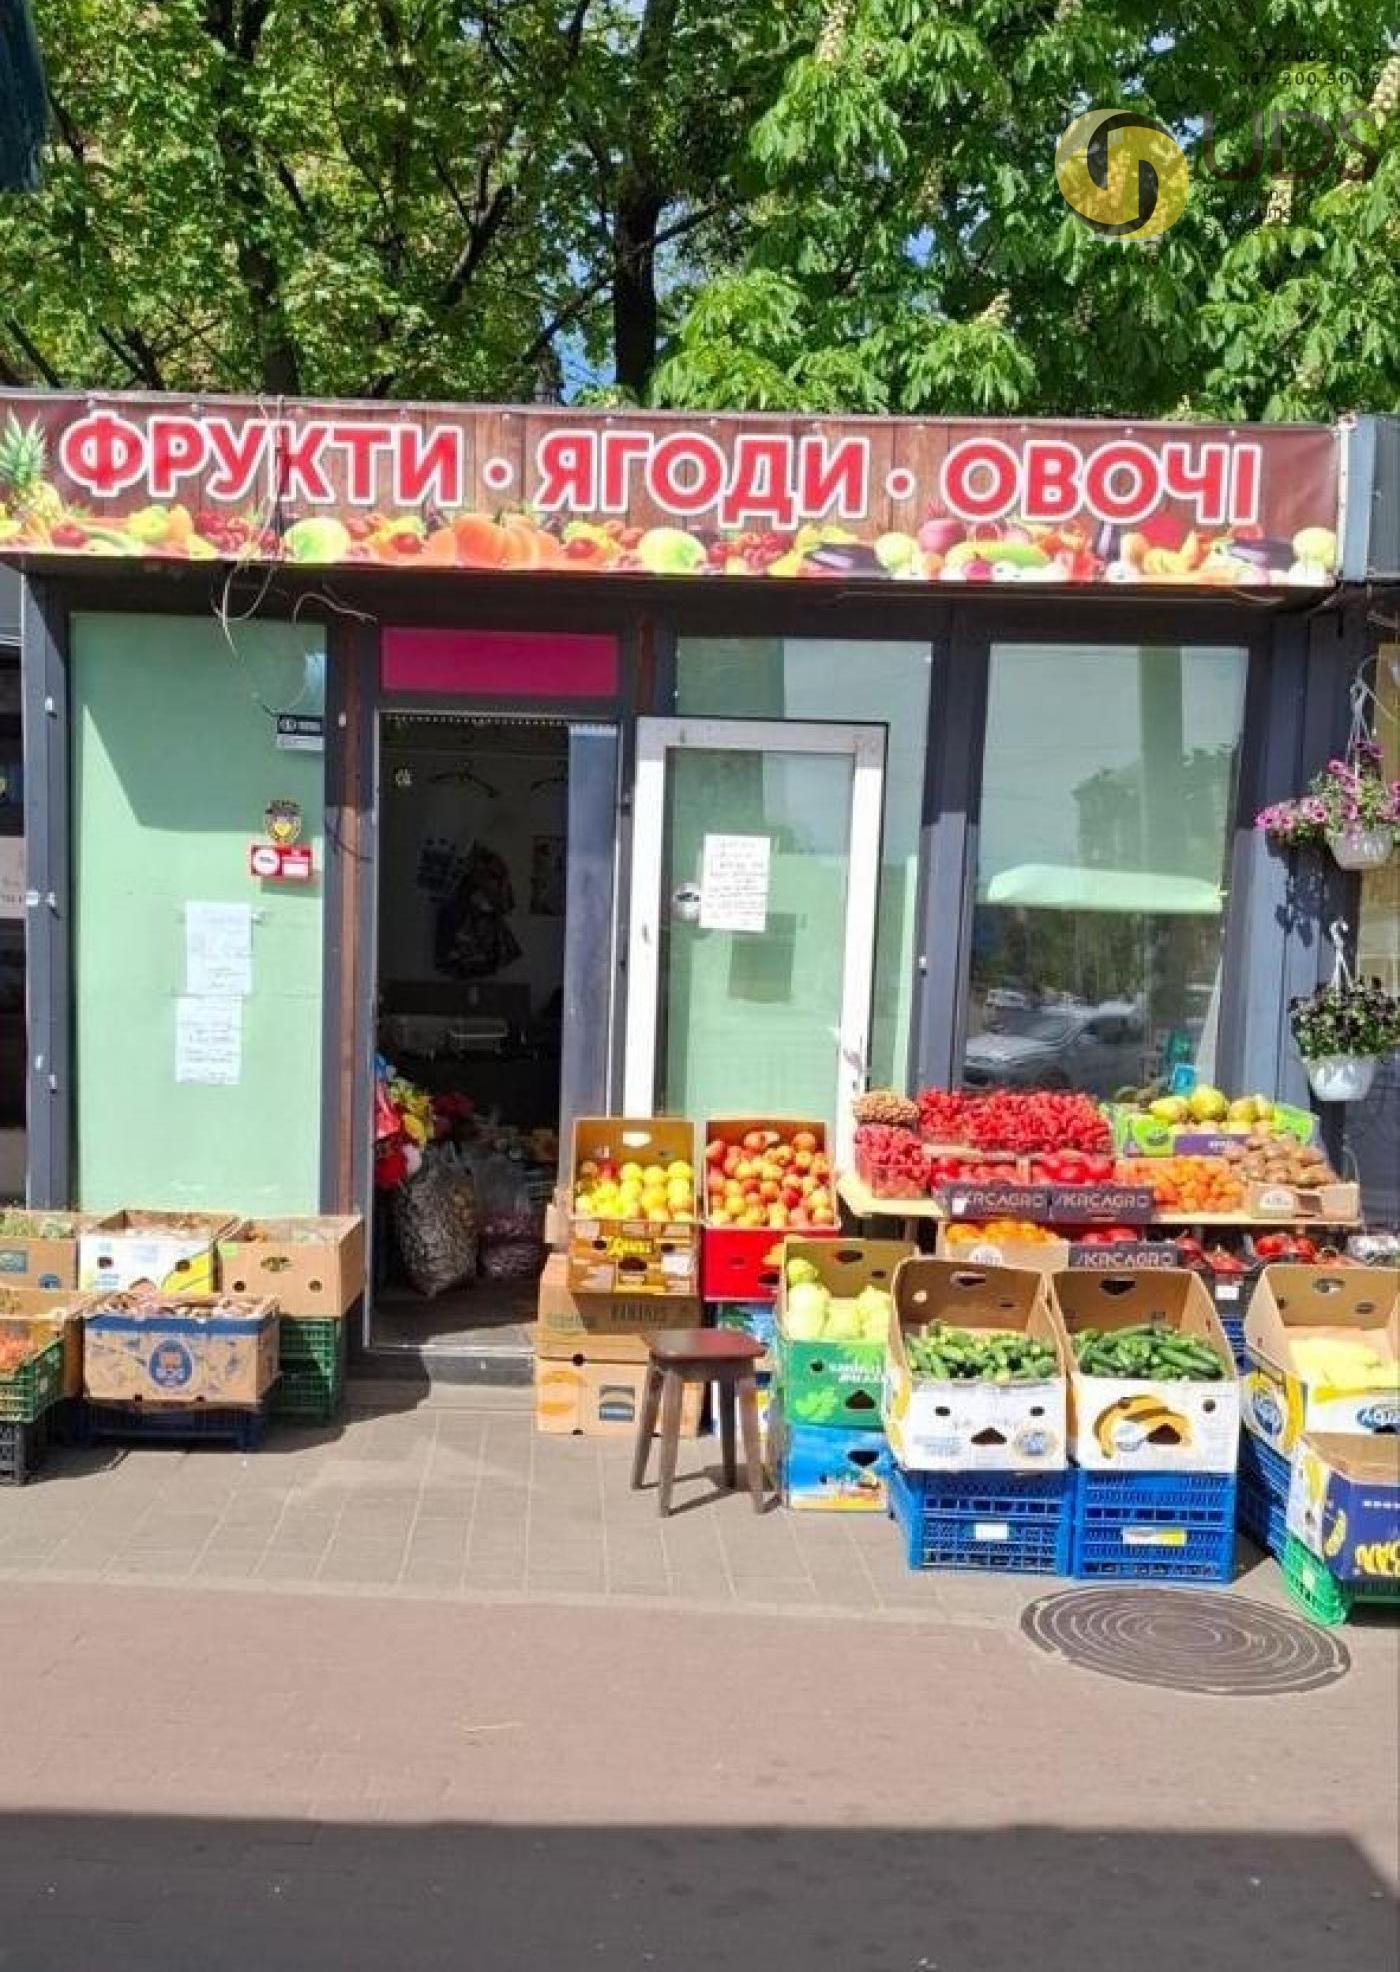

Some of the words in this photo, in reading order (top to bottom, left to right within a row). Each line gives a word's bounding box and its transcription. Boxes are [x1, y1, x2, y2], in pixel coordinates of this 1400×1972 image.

[60, 410, 464, 507] ФРУКТИ
[533, 427, 868, 530] ЯГОДИ
[940, 437, 1263, 525] ОВОЧІ
